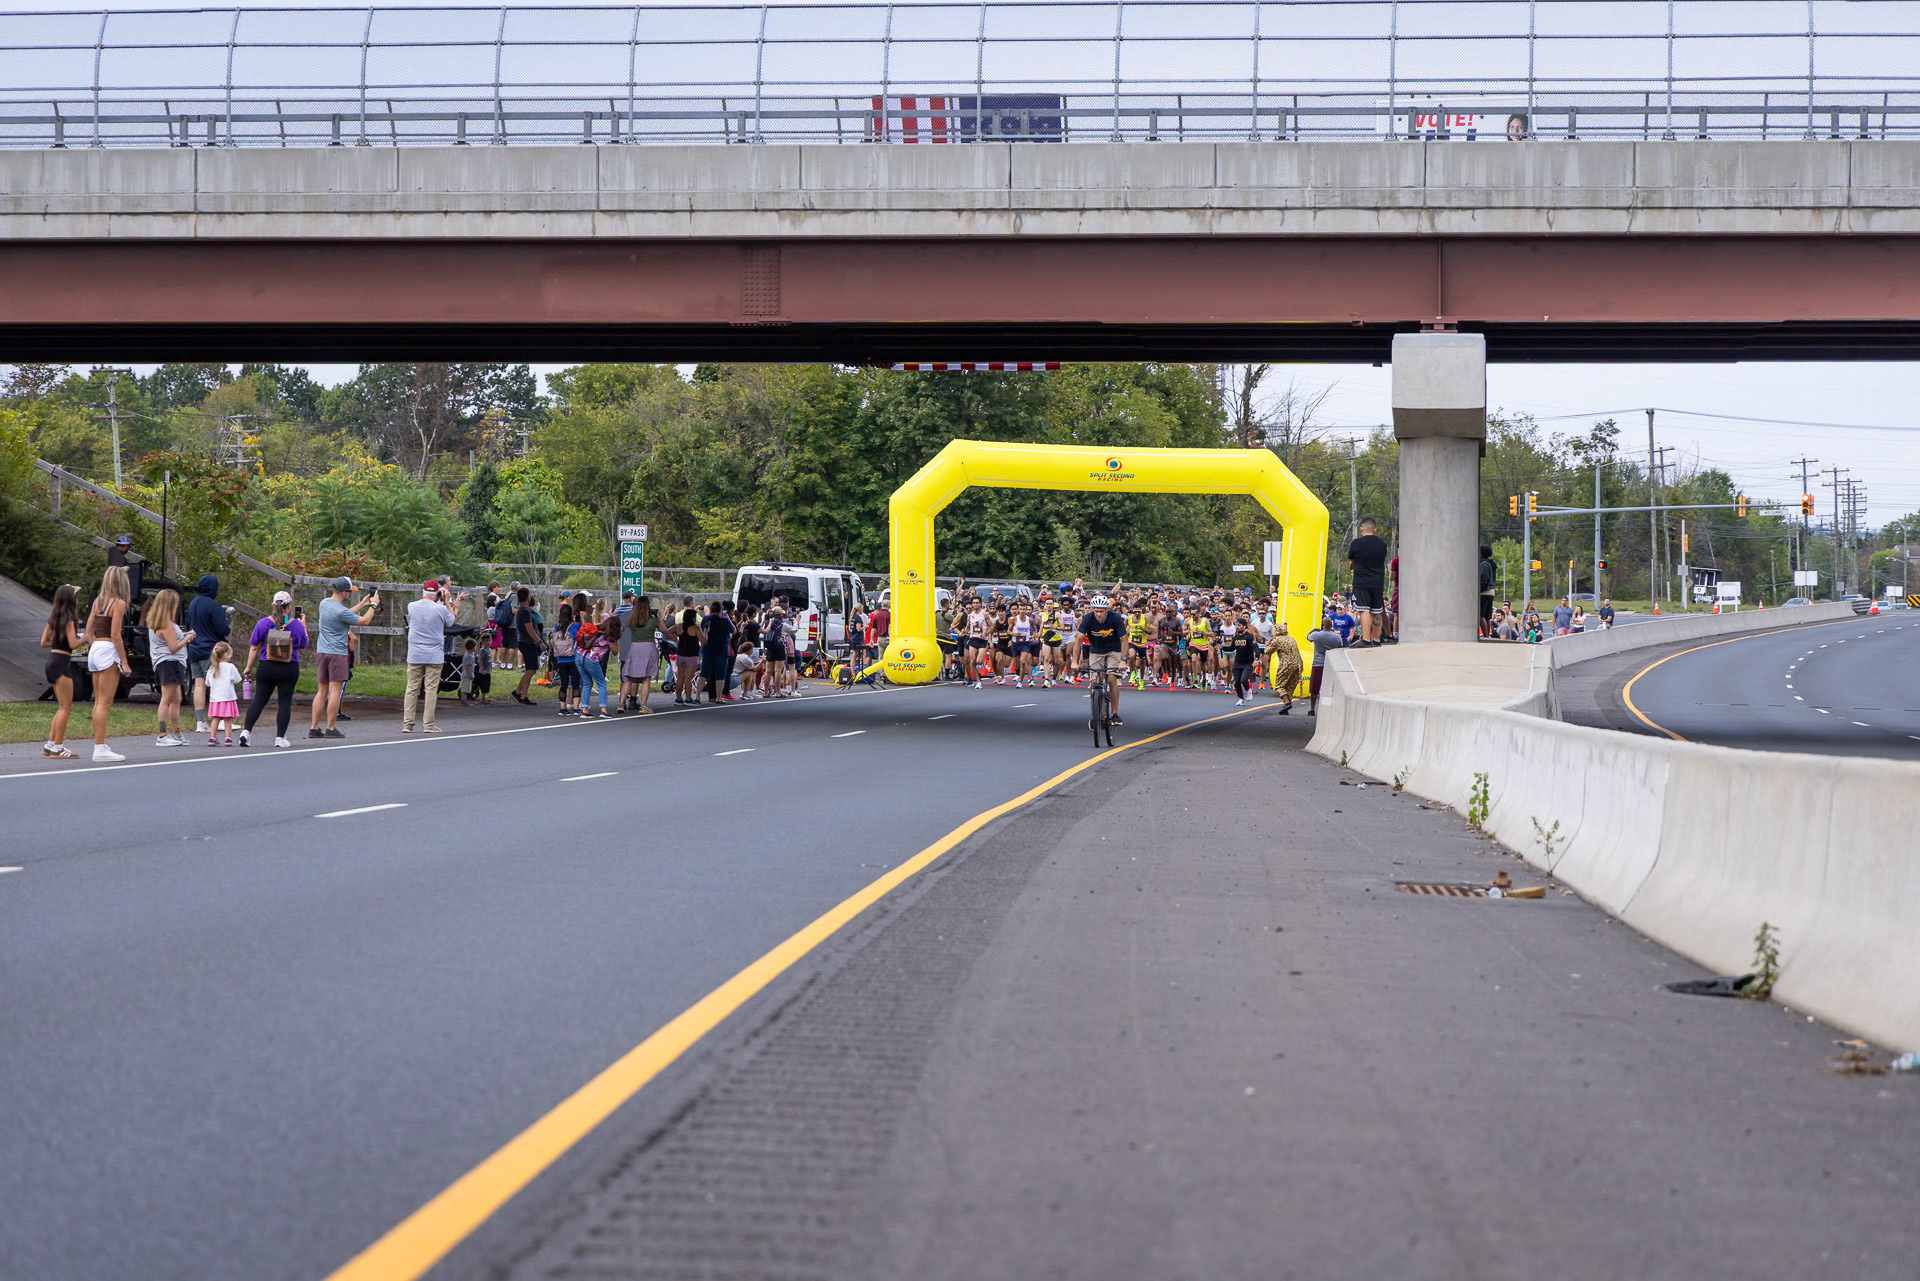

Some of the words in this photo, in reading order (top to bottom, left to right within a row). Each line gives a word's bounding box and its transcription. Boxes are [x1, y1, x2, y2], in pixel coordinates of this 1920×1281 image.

[620, 528, 645, 537] BY-PASS
[623, 544, 642, 554] SOUTH
[624, 560, 640, 570] 206
[623, 577, 641, 587] MILE
